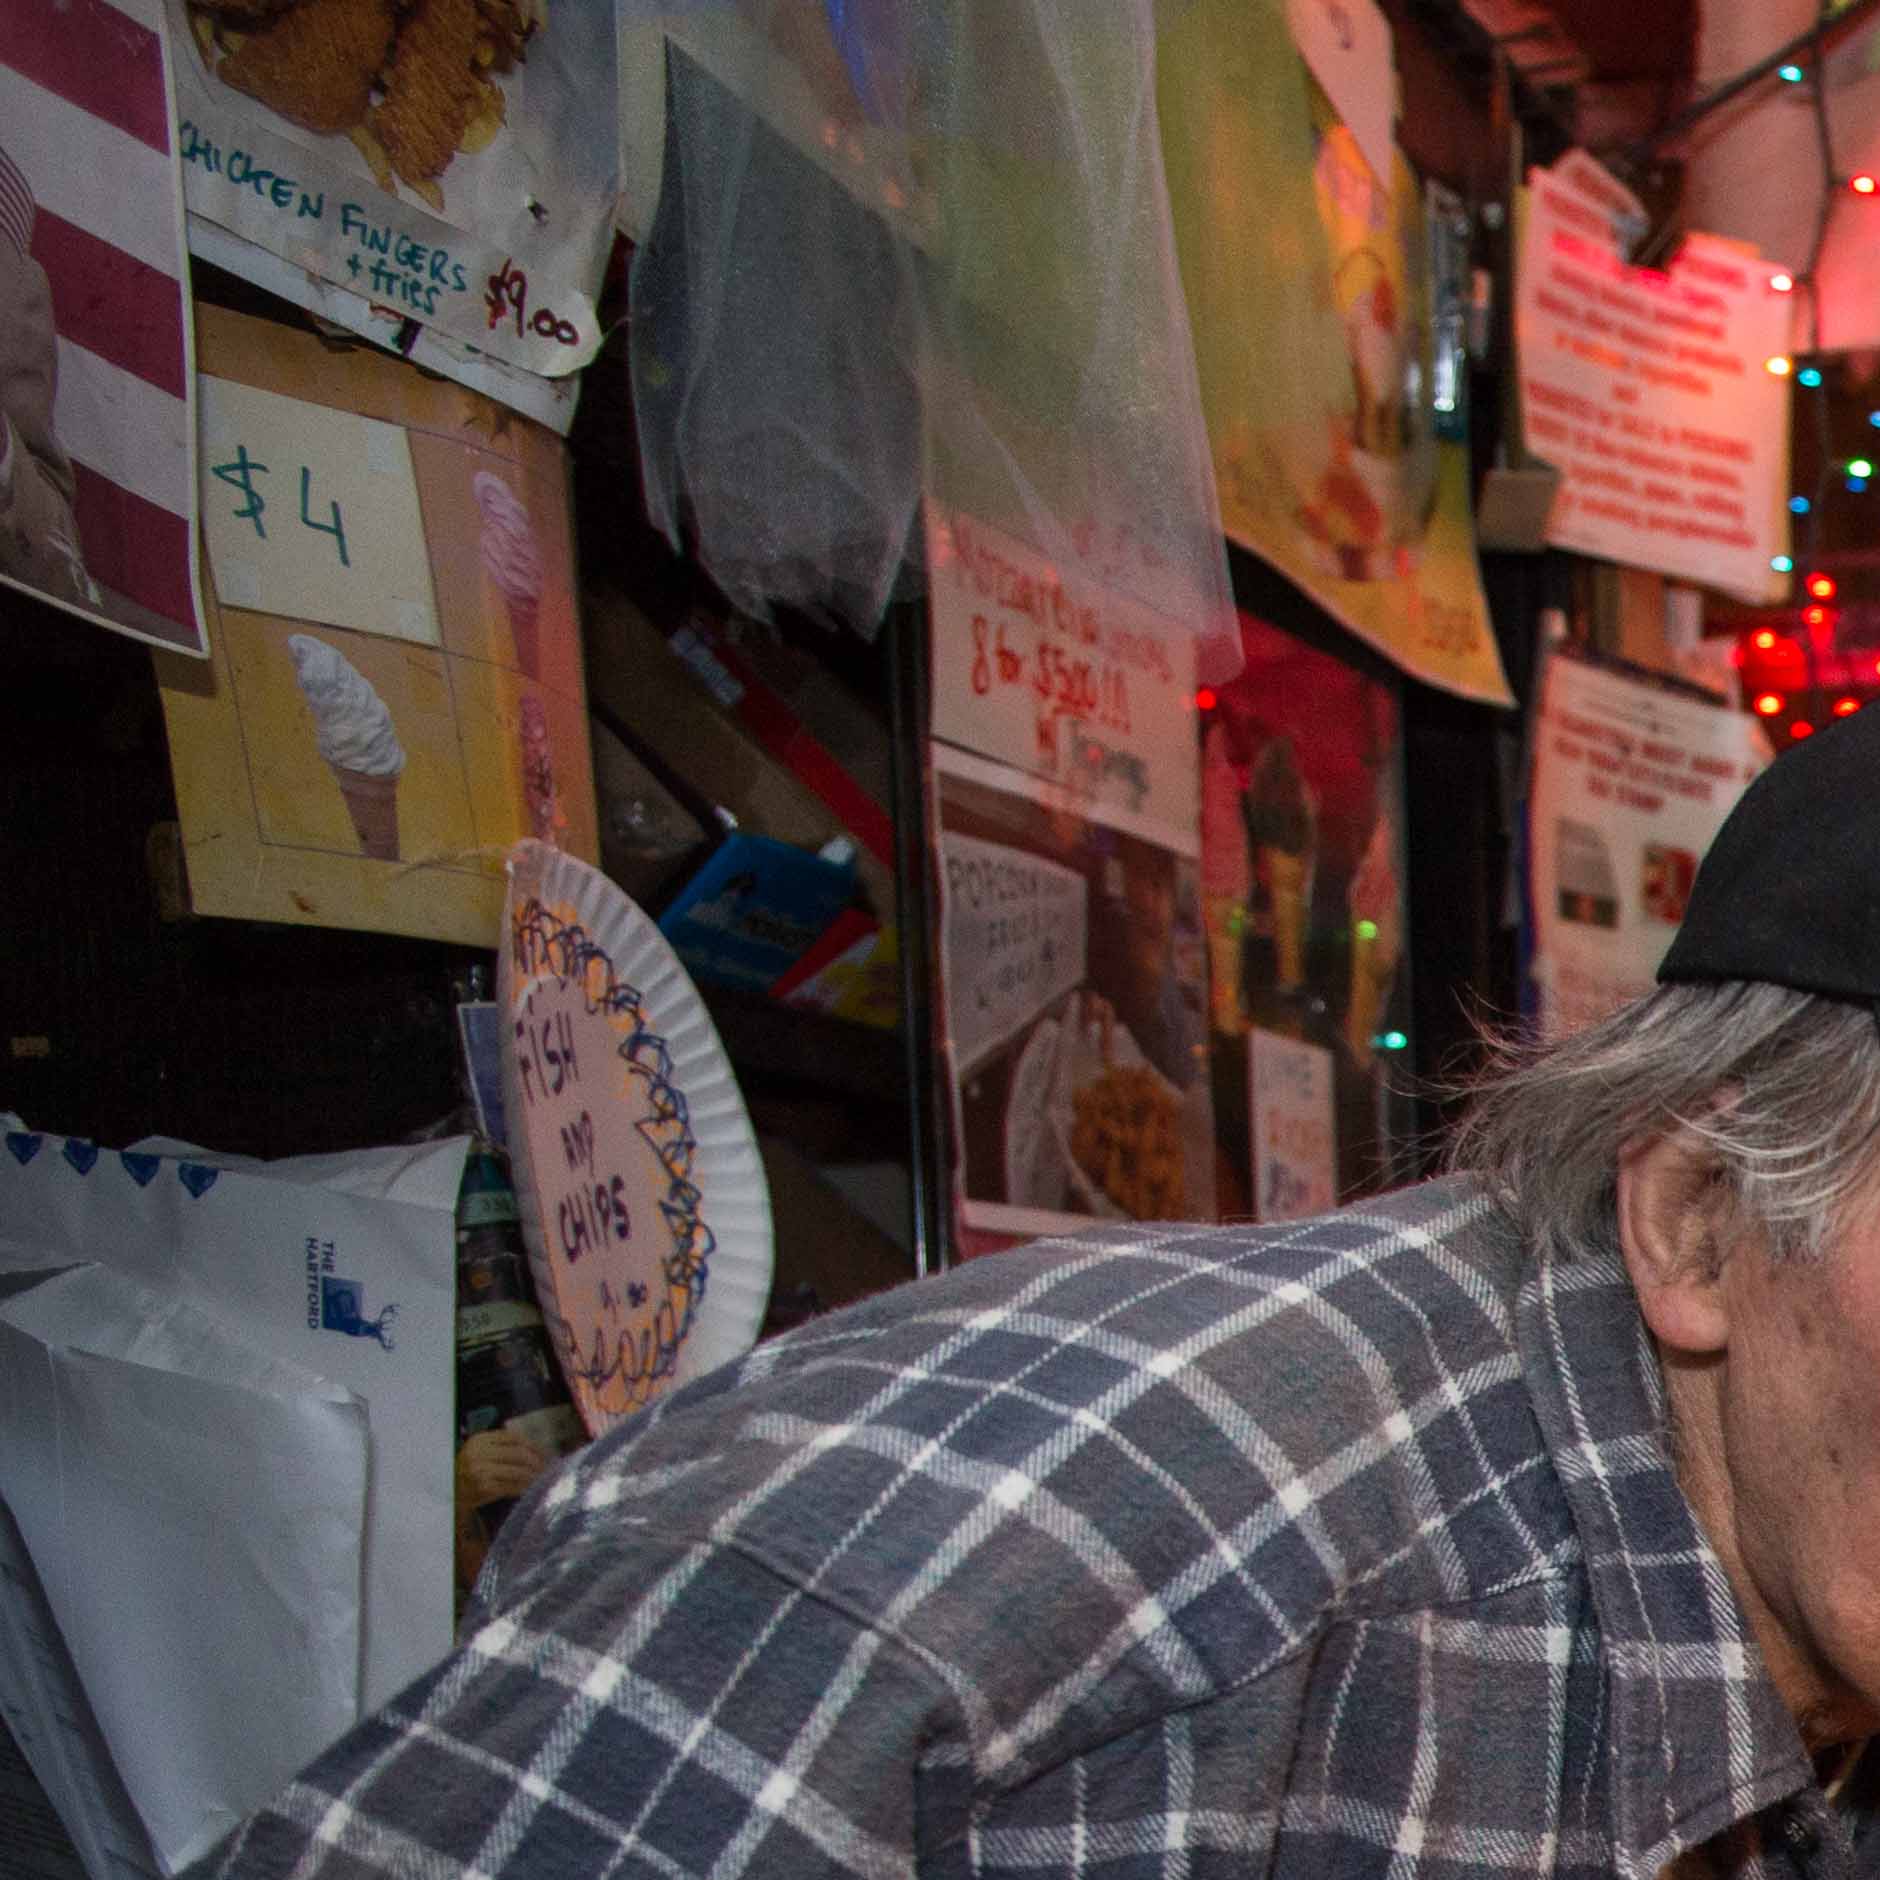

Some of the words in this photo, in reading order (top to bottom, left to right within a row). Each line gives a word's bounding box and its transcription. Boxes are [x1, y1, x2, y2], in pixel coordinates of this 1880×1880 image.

[179, 119, 324, 219] CHICKEN
[341, 203, 468, 293] FINGERS
[484, 257, 580, 346] $9.00
[515, 1008, 581, 1106] FISH
[322, 1240, 336, 1273] THE
[559, 1175, 631, 1264] CHIPS
[306, 1237, 319, 1329] HARTFORD
